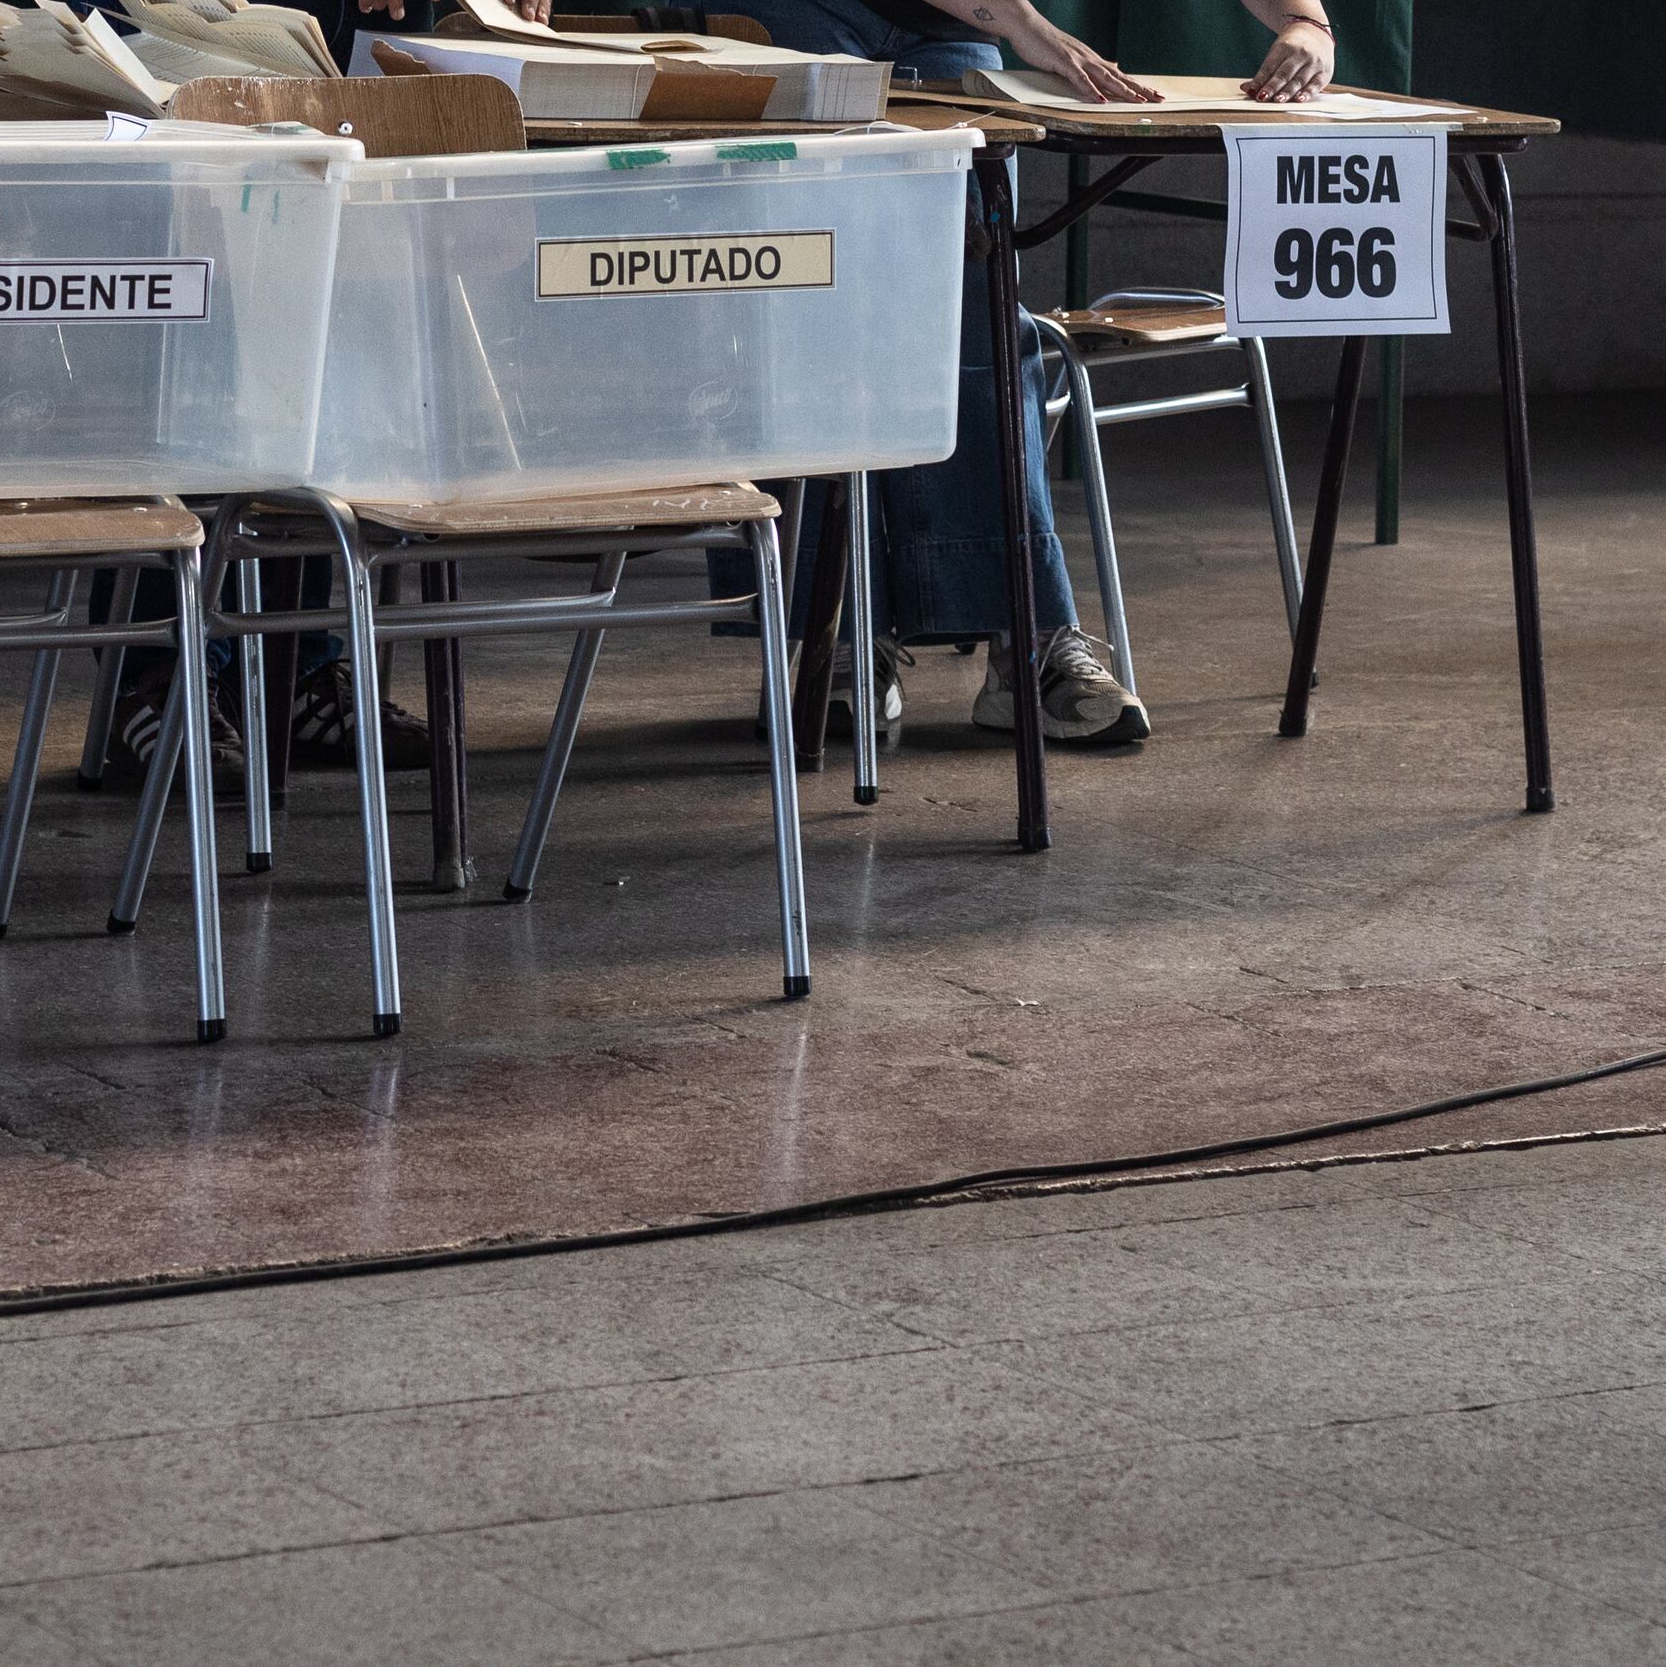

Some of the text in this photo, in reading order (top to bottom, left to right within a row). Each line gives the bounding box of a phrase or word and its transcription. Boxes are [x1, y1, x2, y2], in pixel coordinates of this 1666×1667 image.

[1276, 154, 1401, 204] MESA
[589, 245, 782, 287] DIPUTADO
[1273, 226, 1397, 300] 966
